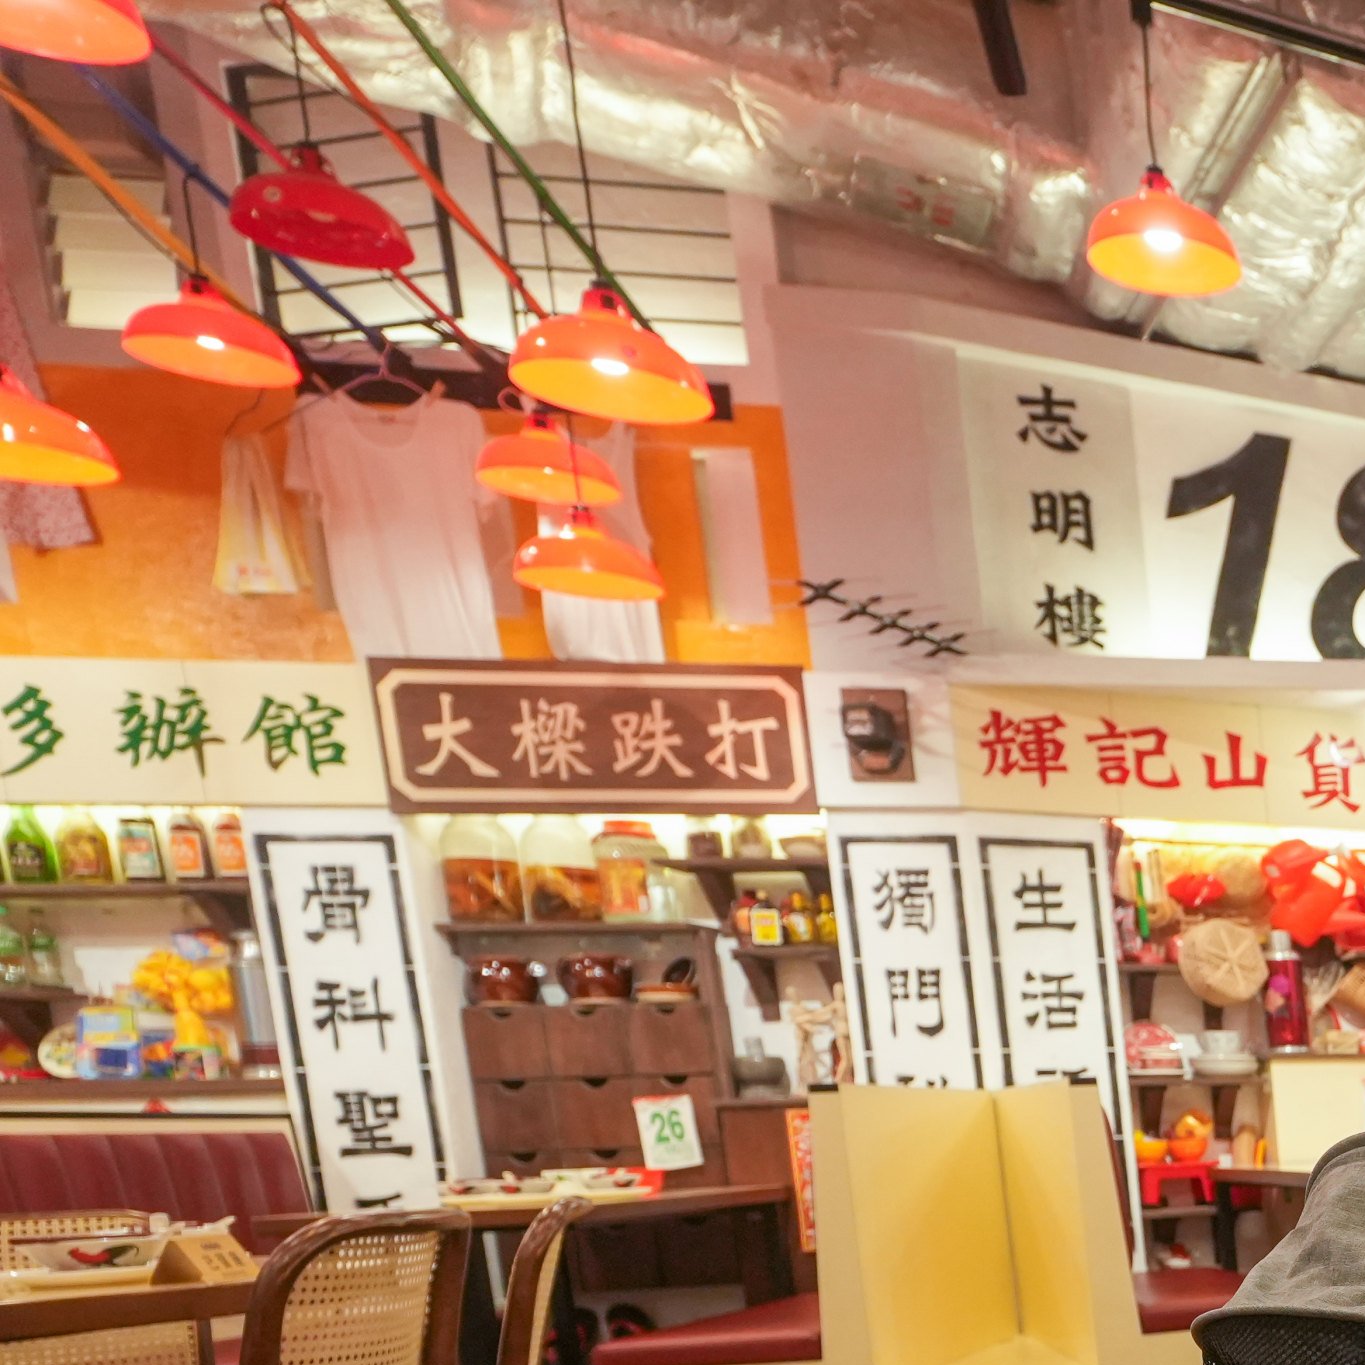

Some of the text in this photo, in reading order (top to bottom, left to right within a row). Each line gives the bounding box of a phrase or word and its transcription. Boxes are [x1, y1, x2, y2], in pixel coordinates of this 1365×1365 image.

[1016, 384, 1107, 650] 志明樓
[1, 682, 347, 778] 多辦館
[414, 691, 781, 781] 大樑跌打
[302, 864, 413, 1209] 骨科聖
[872, 866, 949, 1087] 獨門
[1012, 867, 1089, 1077] 生活
[650, 1109, 686, 1143] 26
